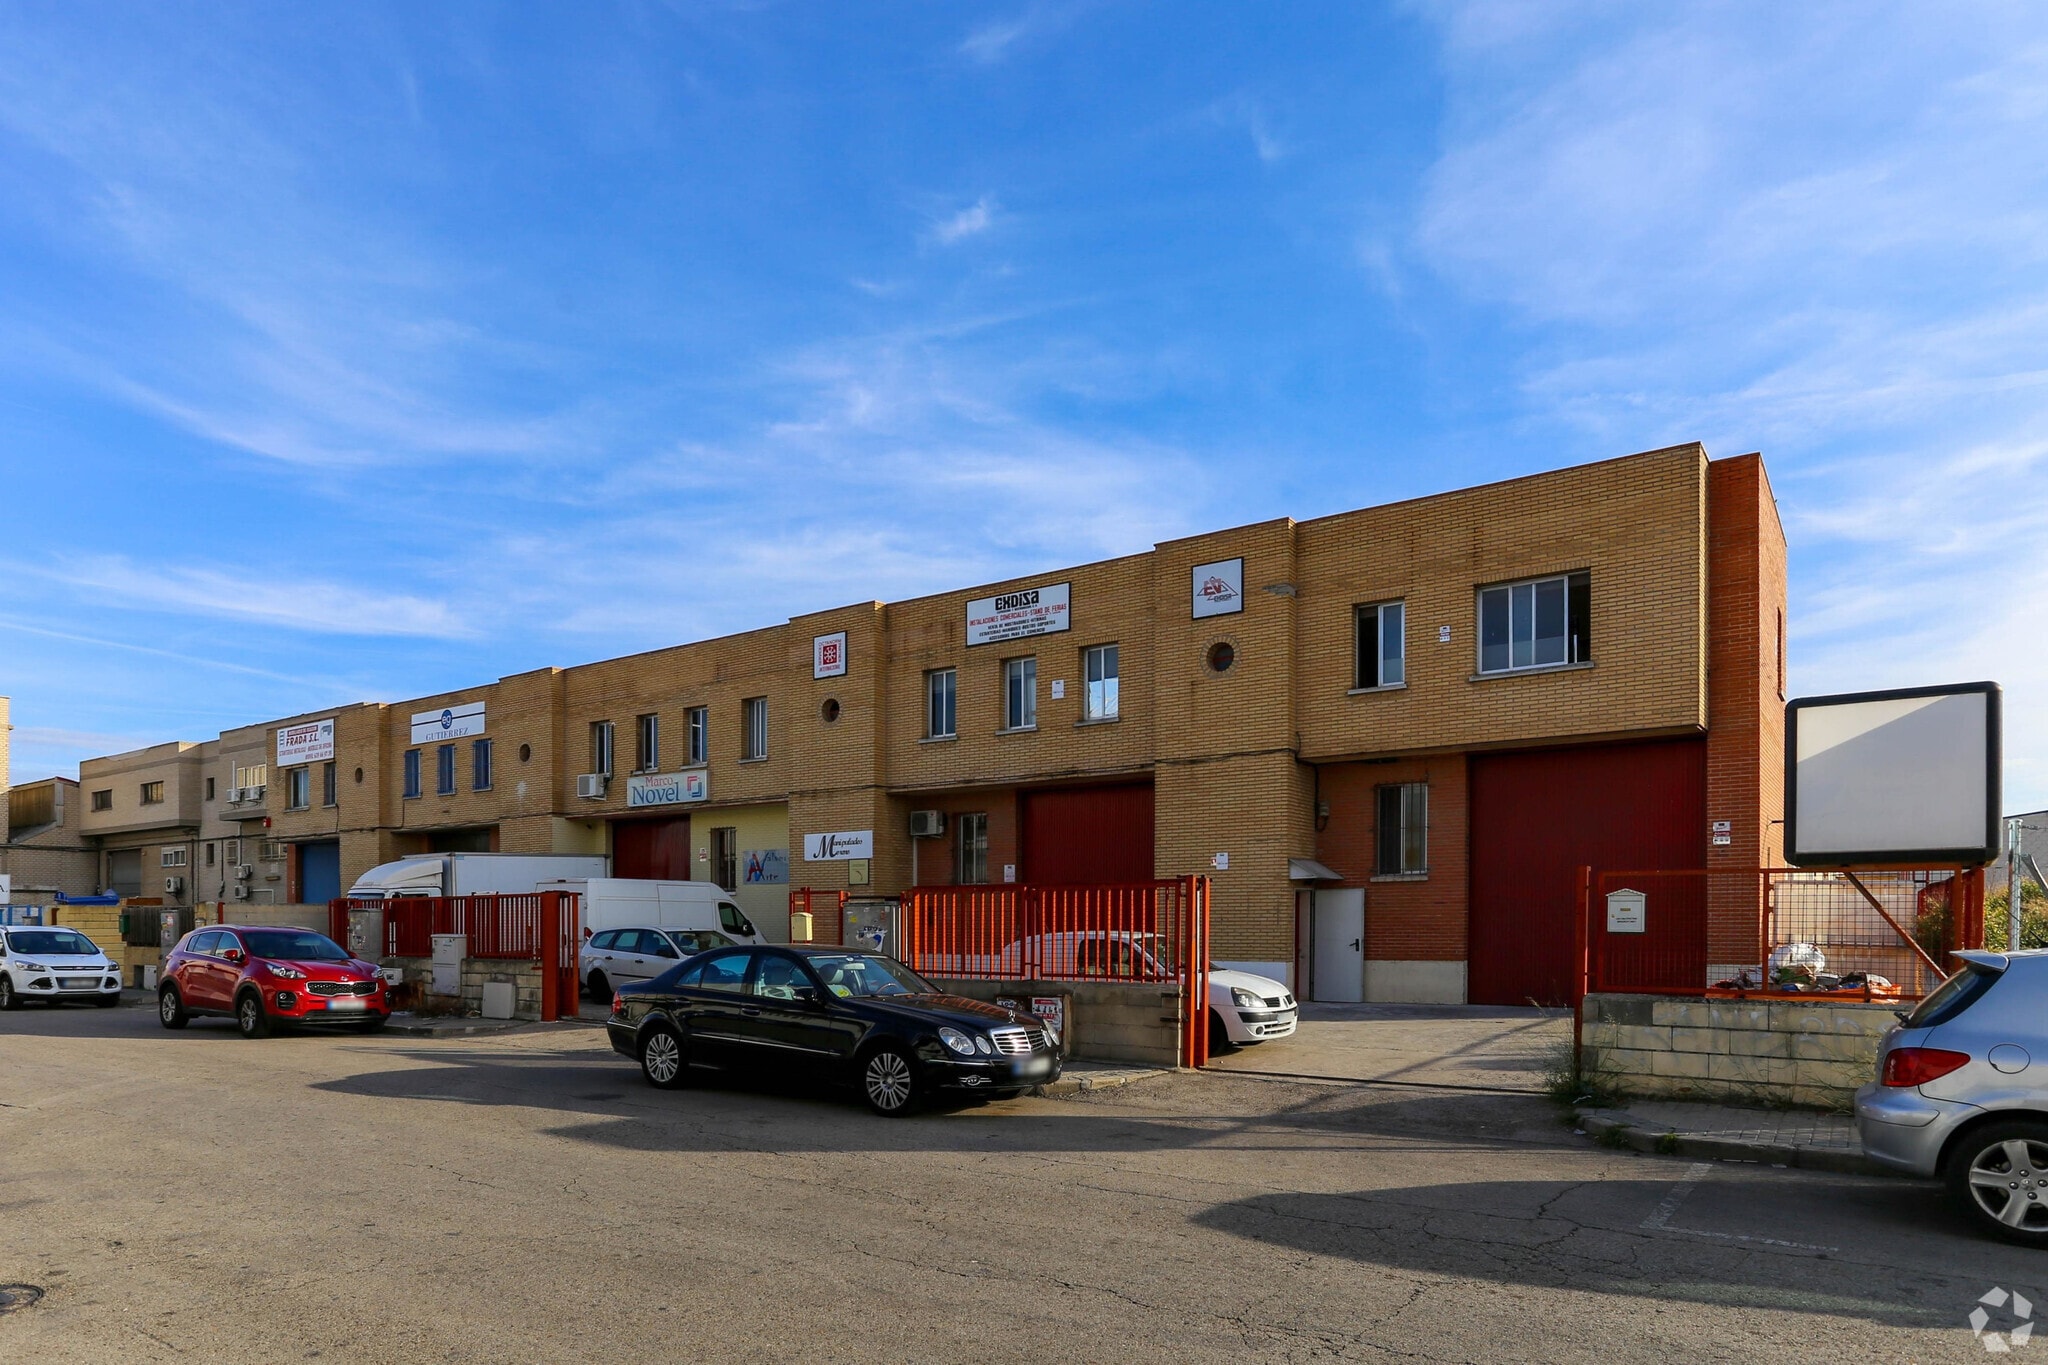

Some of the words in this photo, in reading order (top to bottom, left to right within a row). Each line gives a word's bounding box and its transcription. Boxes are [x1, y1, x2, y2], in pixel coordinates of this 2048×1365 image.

[969, 616, 999, 627] INSTALACIONES
[1051, 603, 1067, 612] FERIAS
[425, 727, 469, 741] GUTIERREZ
[644, 776, 674, 787] Marco
[631, 781, 680, 805] Novel
